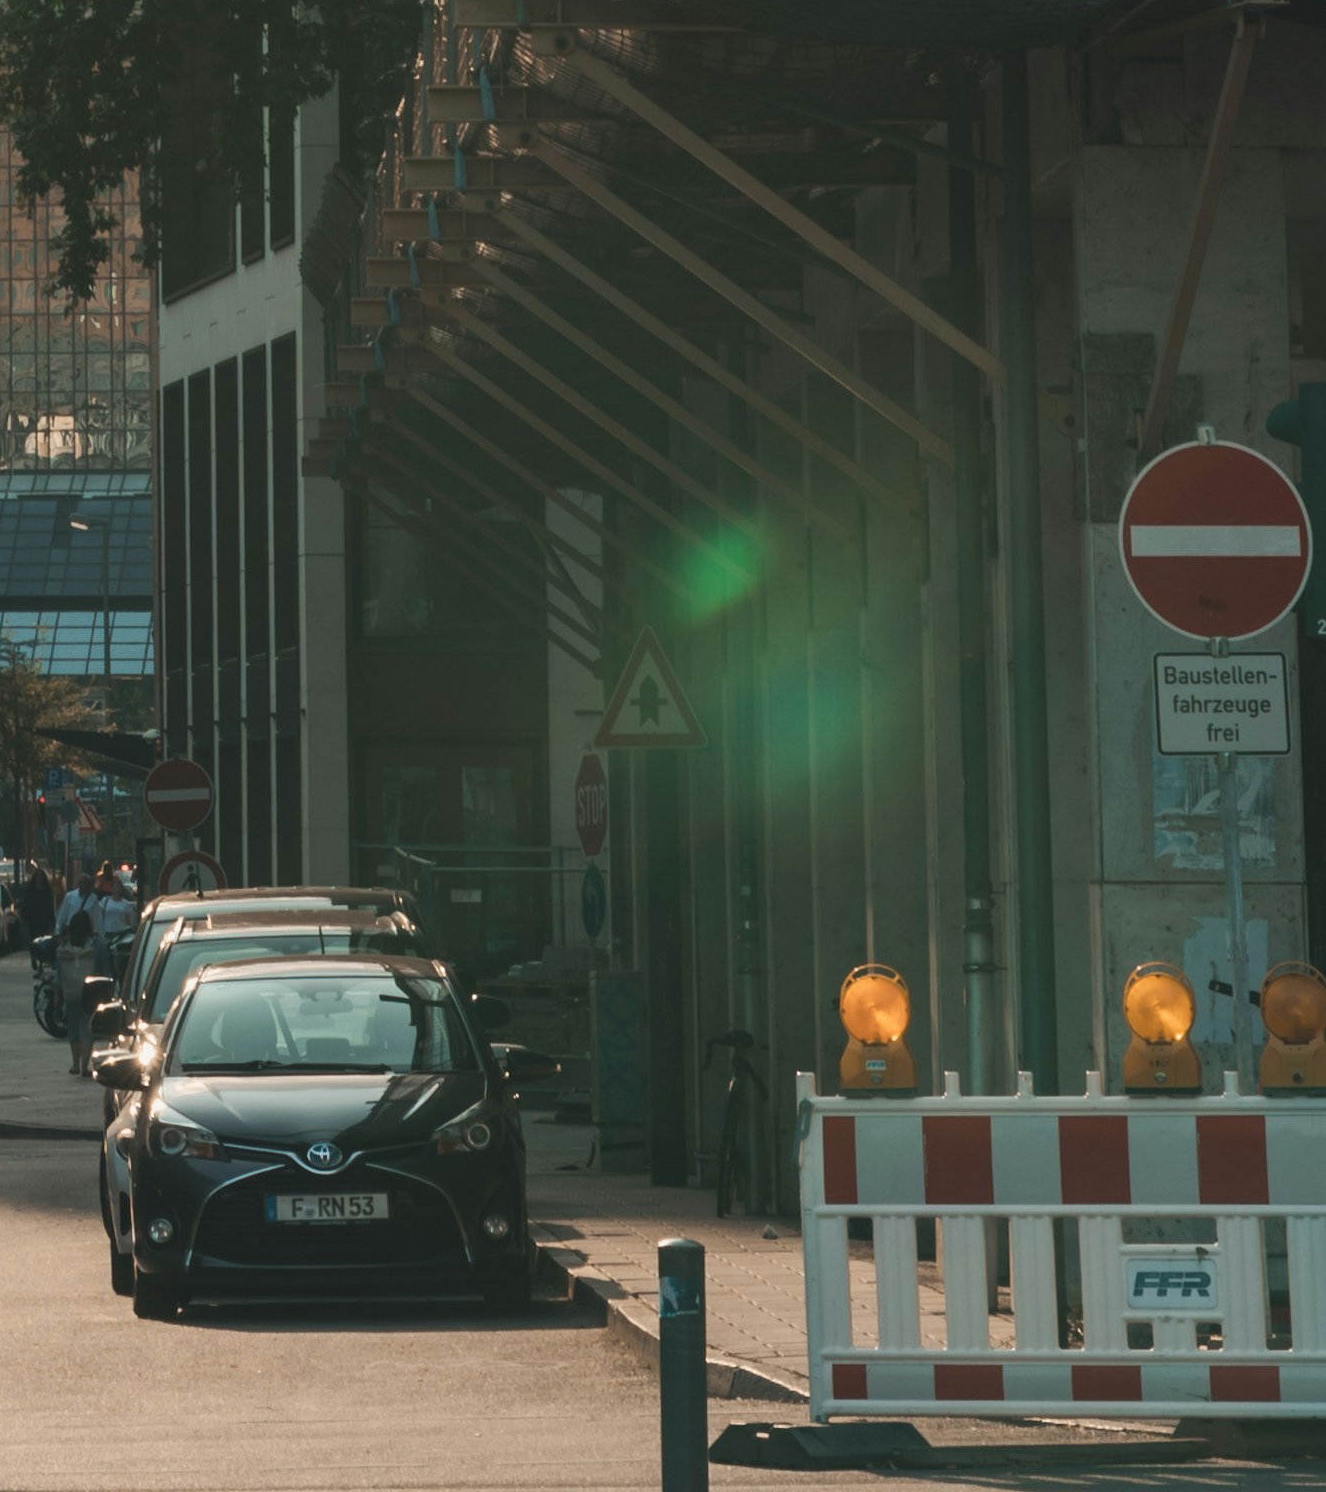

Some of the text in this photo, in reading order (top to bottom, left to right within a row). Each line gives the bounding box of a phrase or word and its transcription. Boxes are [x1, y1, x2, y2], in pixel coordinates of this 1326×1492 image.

[1163, 665, 1278, 685] Baustellen-
[1172, 694, 1272, 718] fahrzeuge
[1206, 723, 1241, 742] frei
[578, 783, 606, 827] STOP
[291, 1197, 305, 1218] F
[317, 1196, 345, 1217] RN
[349, 1195, 375, 1217] 53
[1132, 1271, 1212, 1297] FFR
